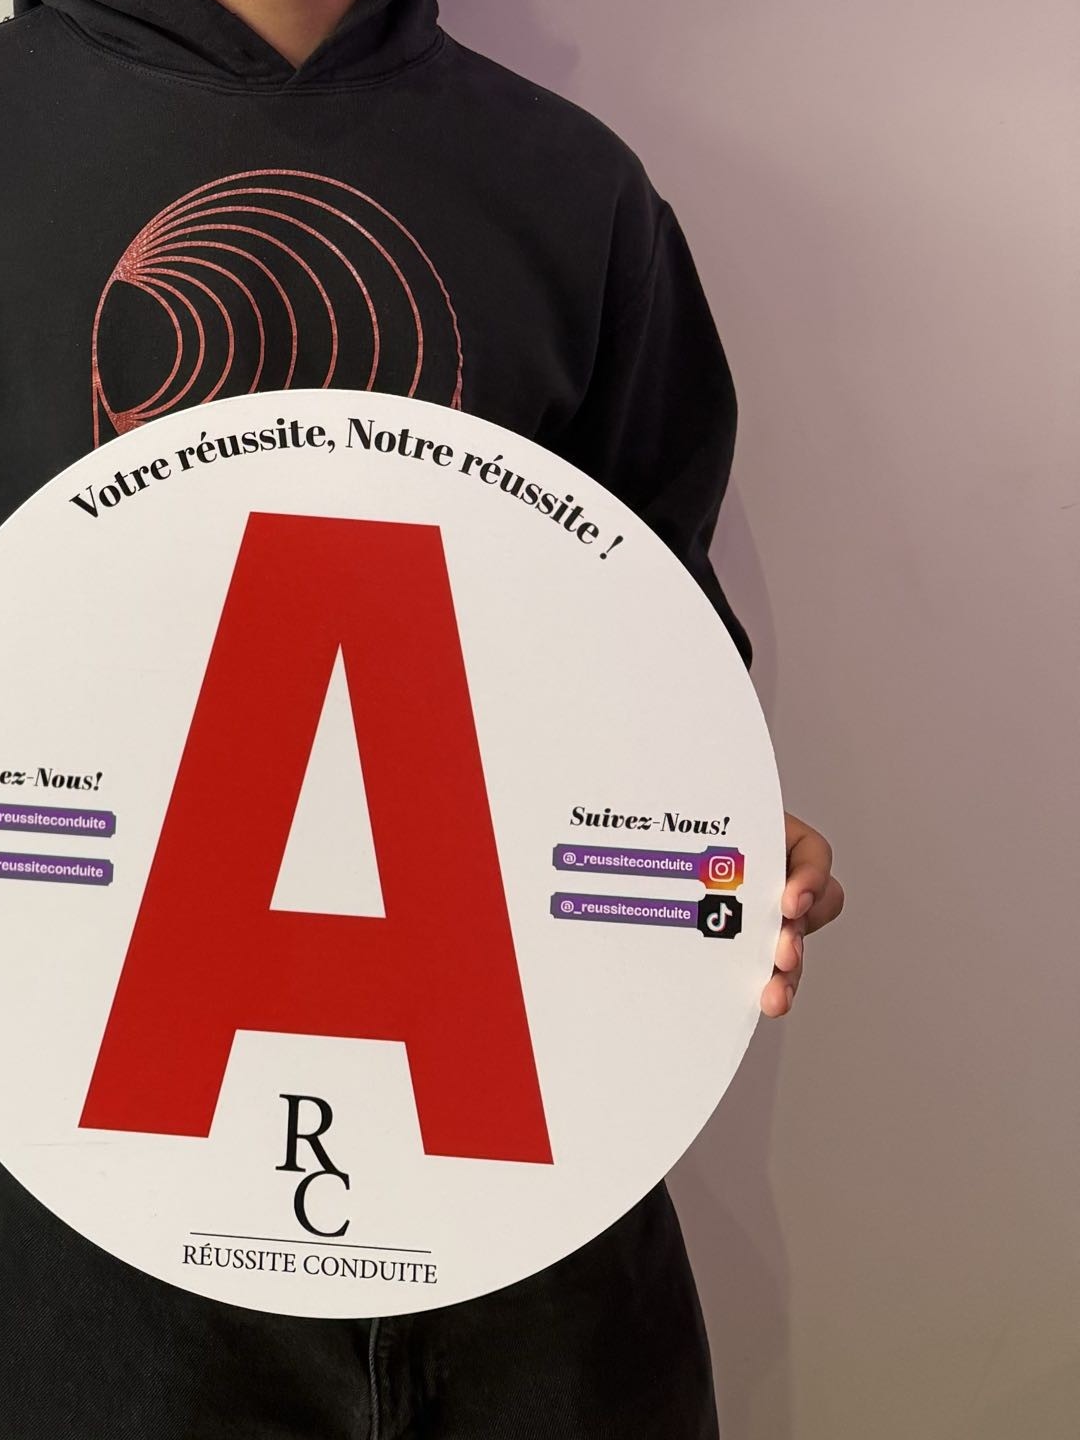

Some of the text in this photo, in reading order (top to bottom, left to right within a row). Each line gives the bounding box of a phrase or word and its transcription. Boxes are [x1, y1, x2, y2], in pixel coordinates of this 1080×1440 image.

[69, 458, 172, 520] Votre
[175, 417, 337, 472] réussite,
[345, 417, 454, 467] Notre
[458, 453, 600, 545] réussite
[79, 512, 554, 1165] A
[570, 806, 731, 836] Suivez-Nous!
[562, 852, 694, 872] @_reussiteconduite
[560, 900, 692, 920] @_reussiteconduite
[182, 1243, 438, 1284] RÉUSSITE CONDUITE
